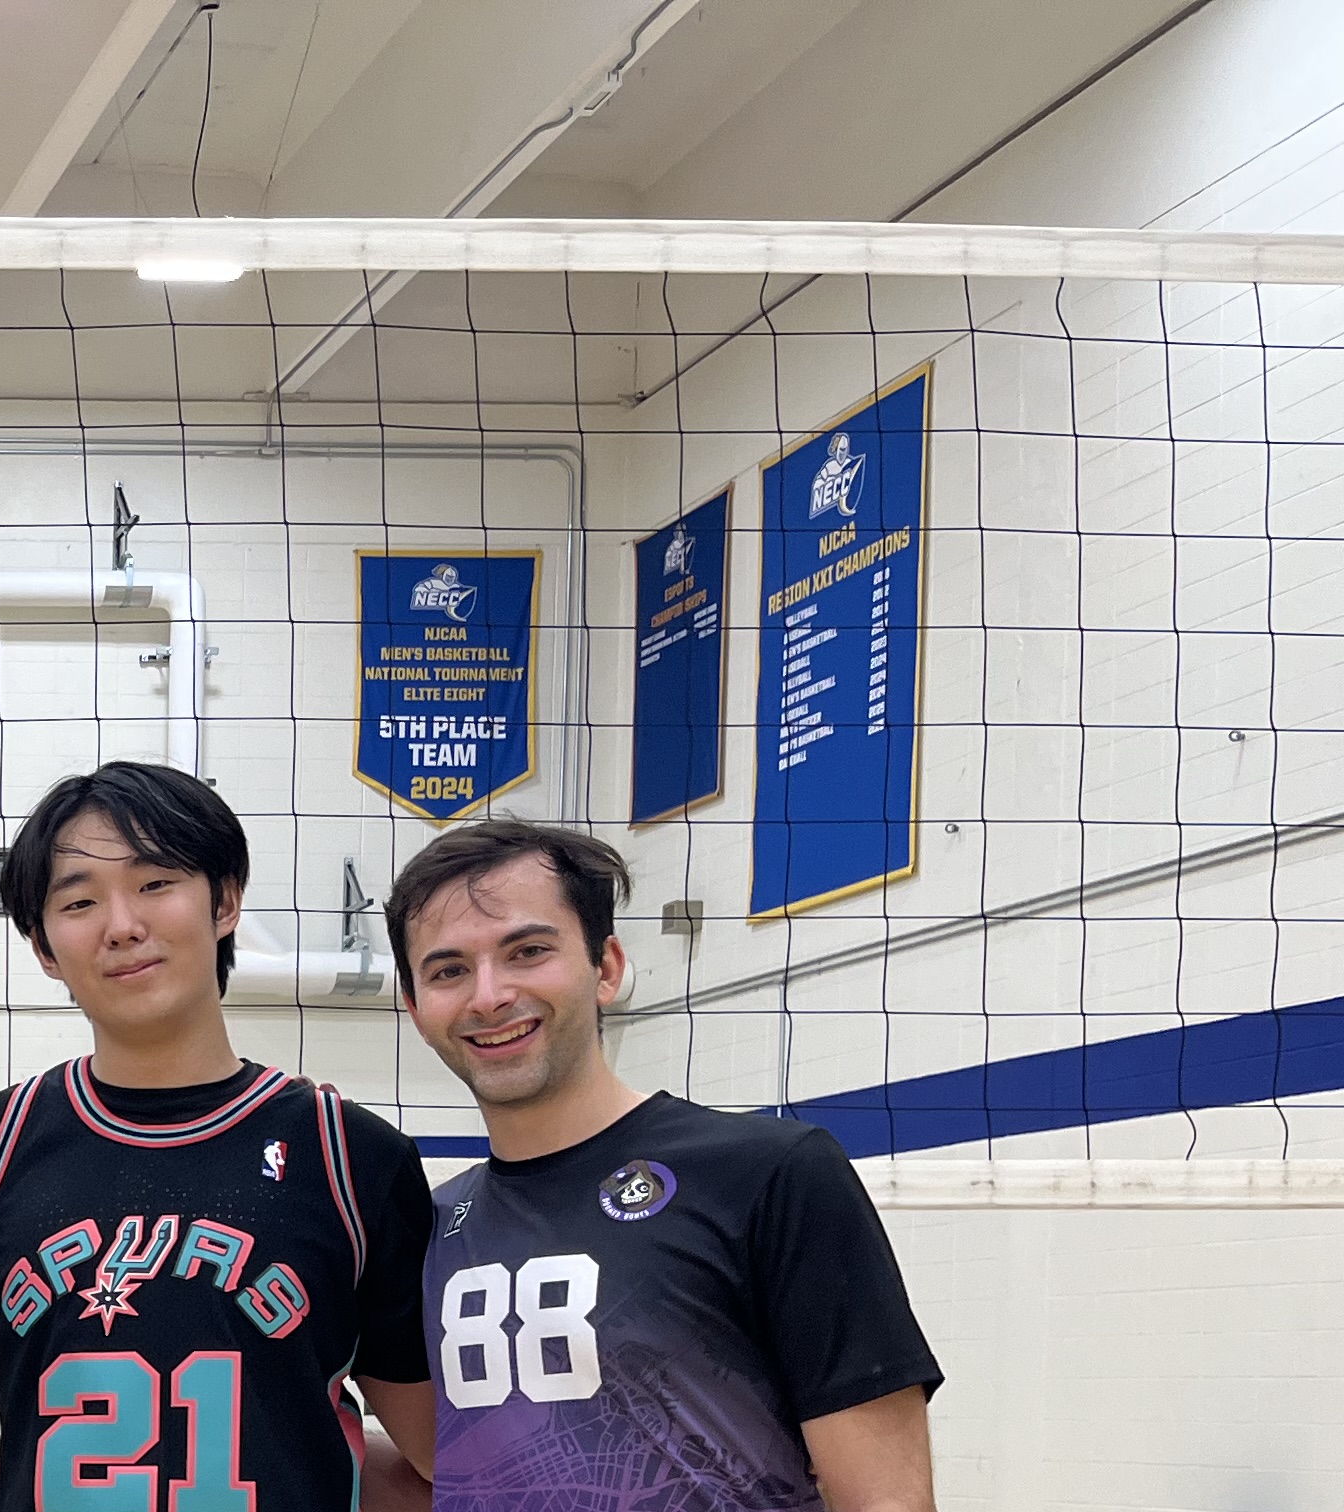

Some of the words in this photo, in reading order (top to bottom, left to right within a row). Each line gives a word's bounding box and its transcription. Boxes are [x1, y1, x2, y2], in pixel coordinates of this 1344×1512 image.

[812, 471, 852, 512] NECC
[818, 520, 856, 559] NJCAA
[768, 577, 810, 616] REGION
[812, 564, 834, 595] XXI
[835, 525, 911, 582] CHAMPIONS
[415, 591, 459, 607] NECC
[425, 627, 467, 641] NJCAA
[380, 647, 423, 660] MEN'S
[426, 648, 510, 661] BASKETBALL
[365, 667, 431, 681] NATIONAL
[433, 667, 524, 681] TOURNAMENT
[403, 687, 441, 700] ELITE
[444, 688, 486, 701] EIGHT
[379, 715, 426, 739] 5TH
[433, 716, 507, 739] PLACE
[408, 743, 477, 767] TEAM
[410, 777, 474, 800] 2024
[1, 1215, 310, 1339] SPURS
[440, 1253, 602, 1409] 88
